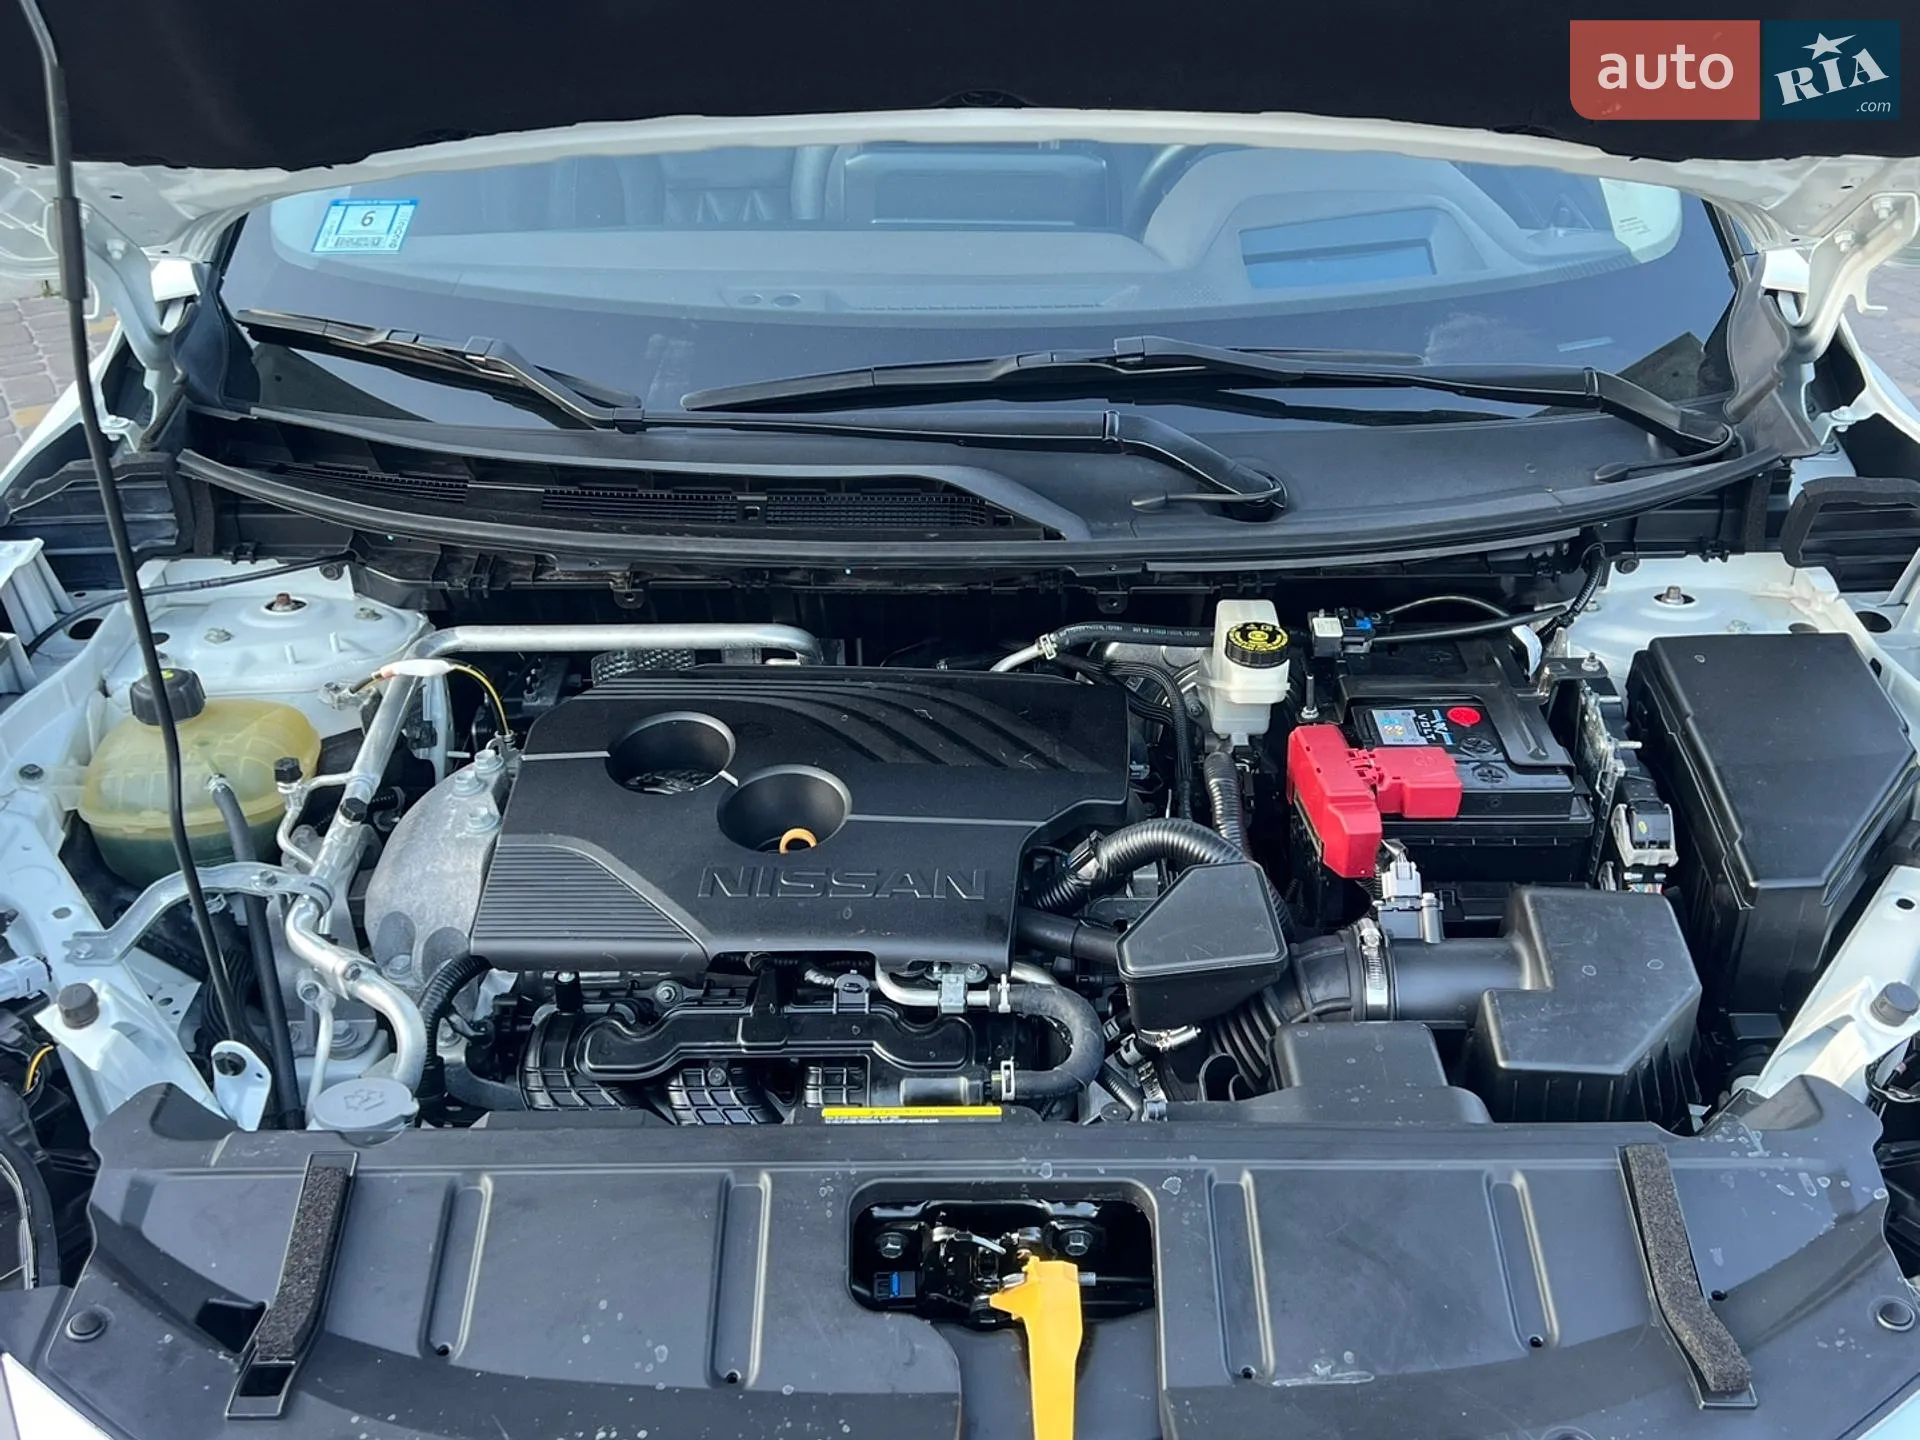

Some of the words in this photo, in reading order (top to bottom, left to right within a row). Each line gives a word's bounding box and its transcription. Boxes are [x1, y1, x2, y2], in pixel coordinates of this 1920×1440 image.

[361, 210, 376, 227] 6
[1418, 713, 1437, 740] VOLT
[697, 865, 989, 900] NISSAN
